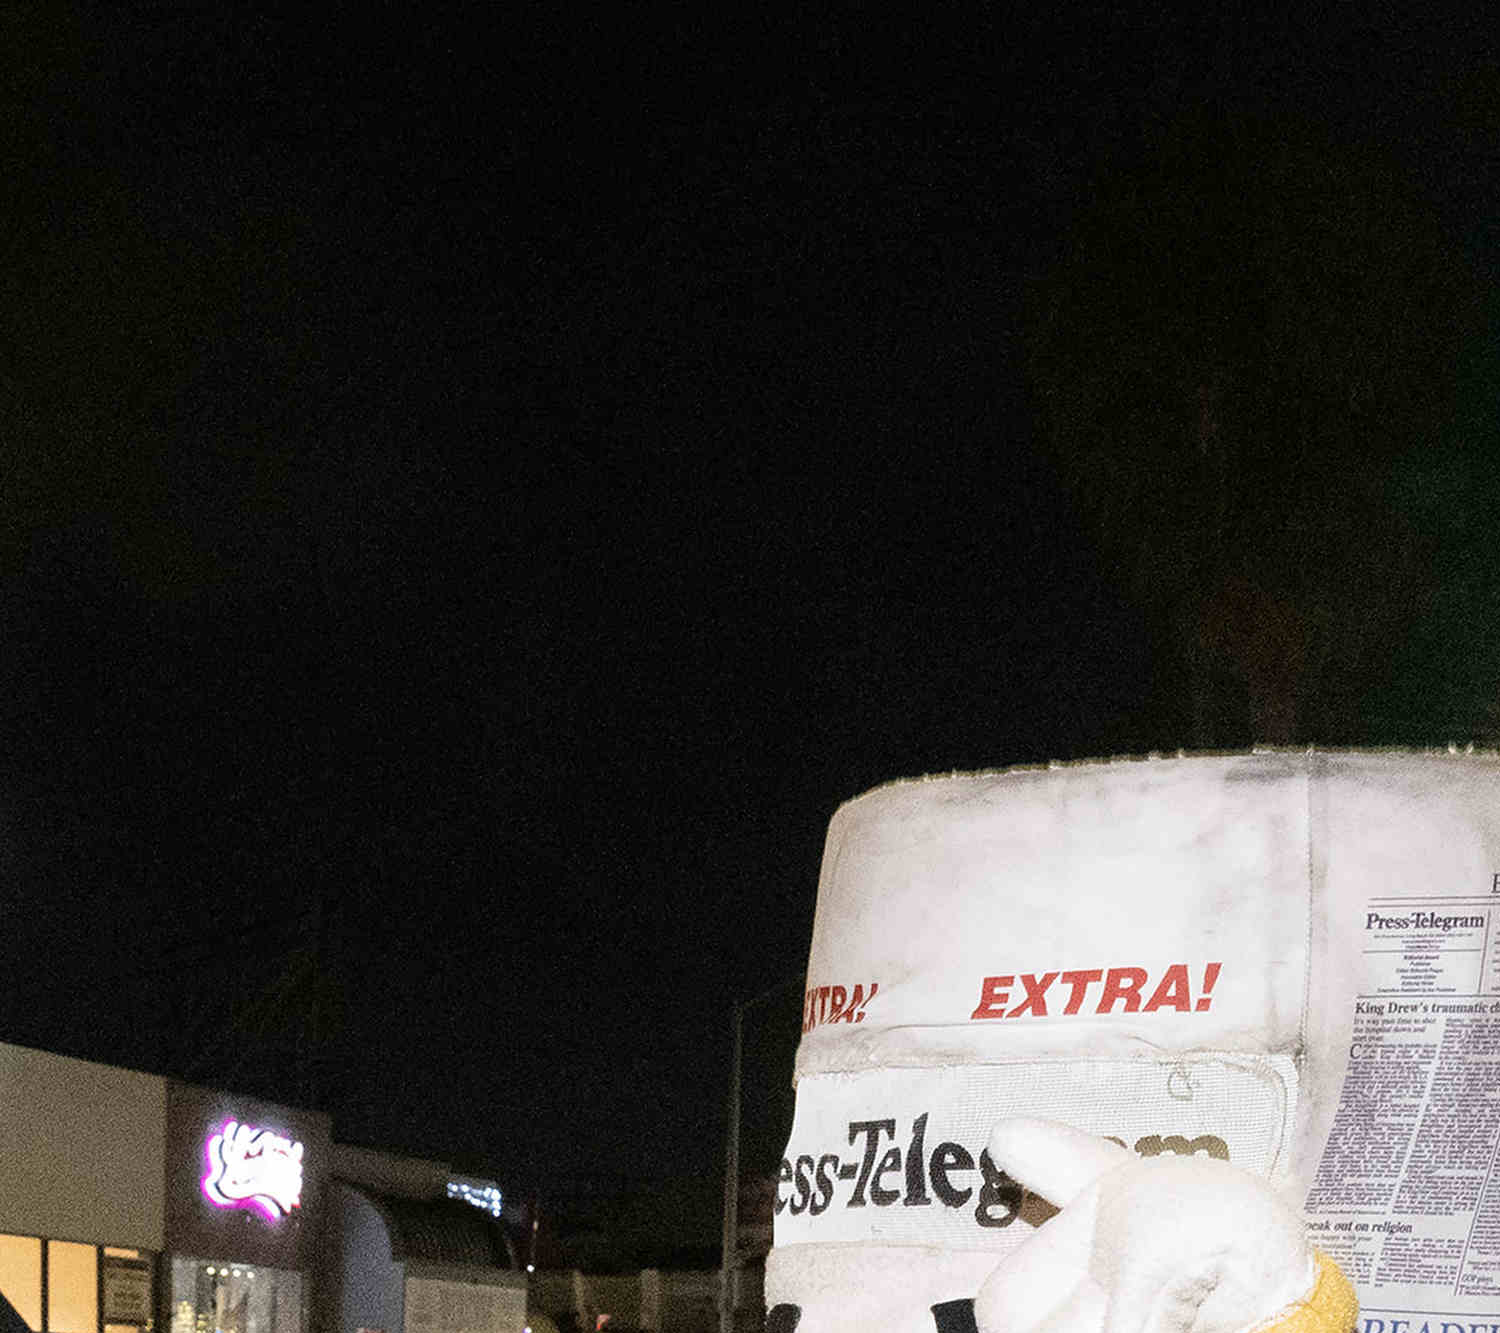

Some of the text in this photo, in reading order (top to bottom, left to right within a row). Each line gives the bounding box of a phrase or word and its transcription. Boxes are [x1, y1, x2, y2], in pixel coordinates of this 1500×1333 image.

[1366, 912, 1484, 932] Press-Telegram
[971, 962, 1222, 1020] EXTRA!
[1355, 1002, 1384, 1015] King
[1388, 1002, 1428, 1013] Drew's
[1432, 1001, 1486, 1014] traumatic
[1372, 1221, 1412, 1235] religion
